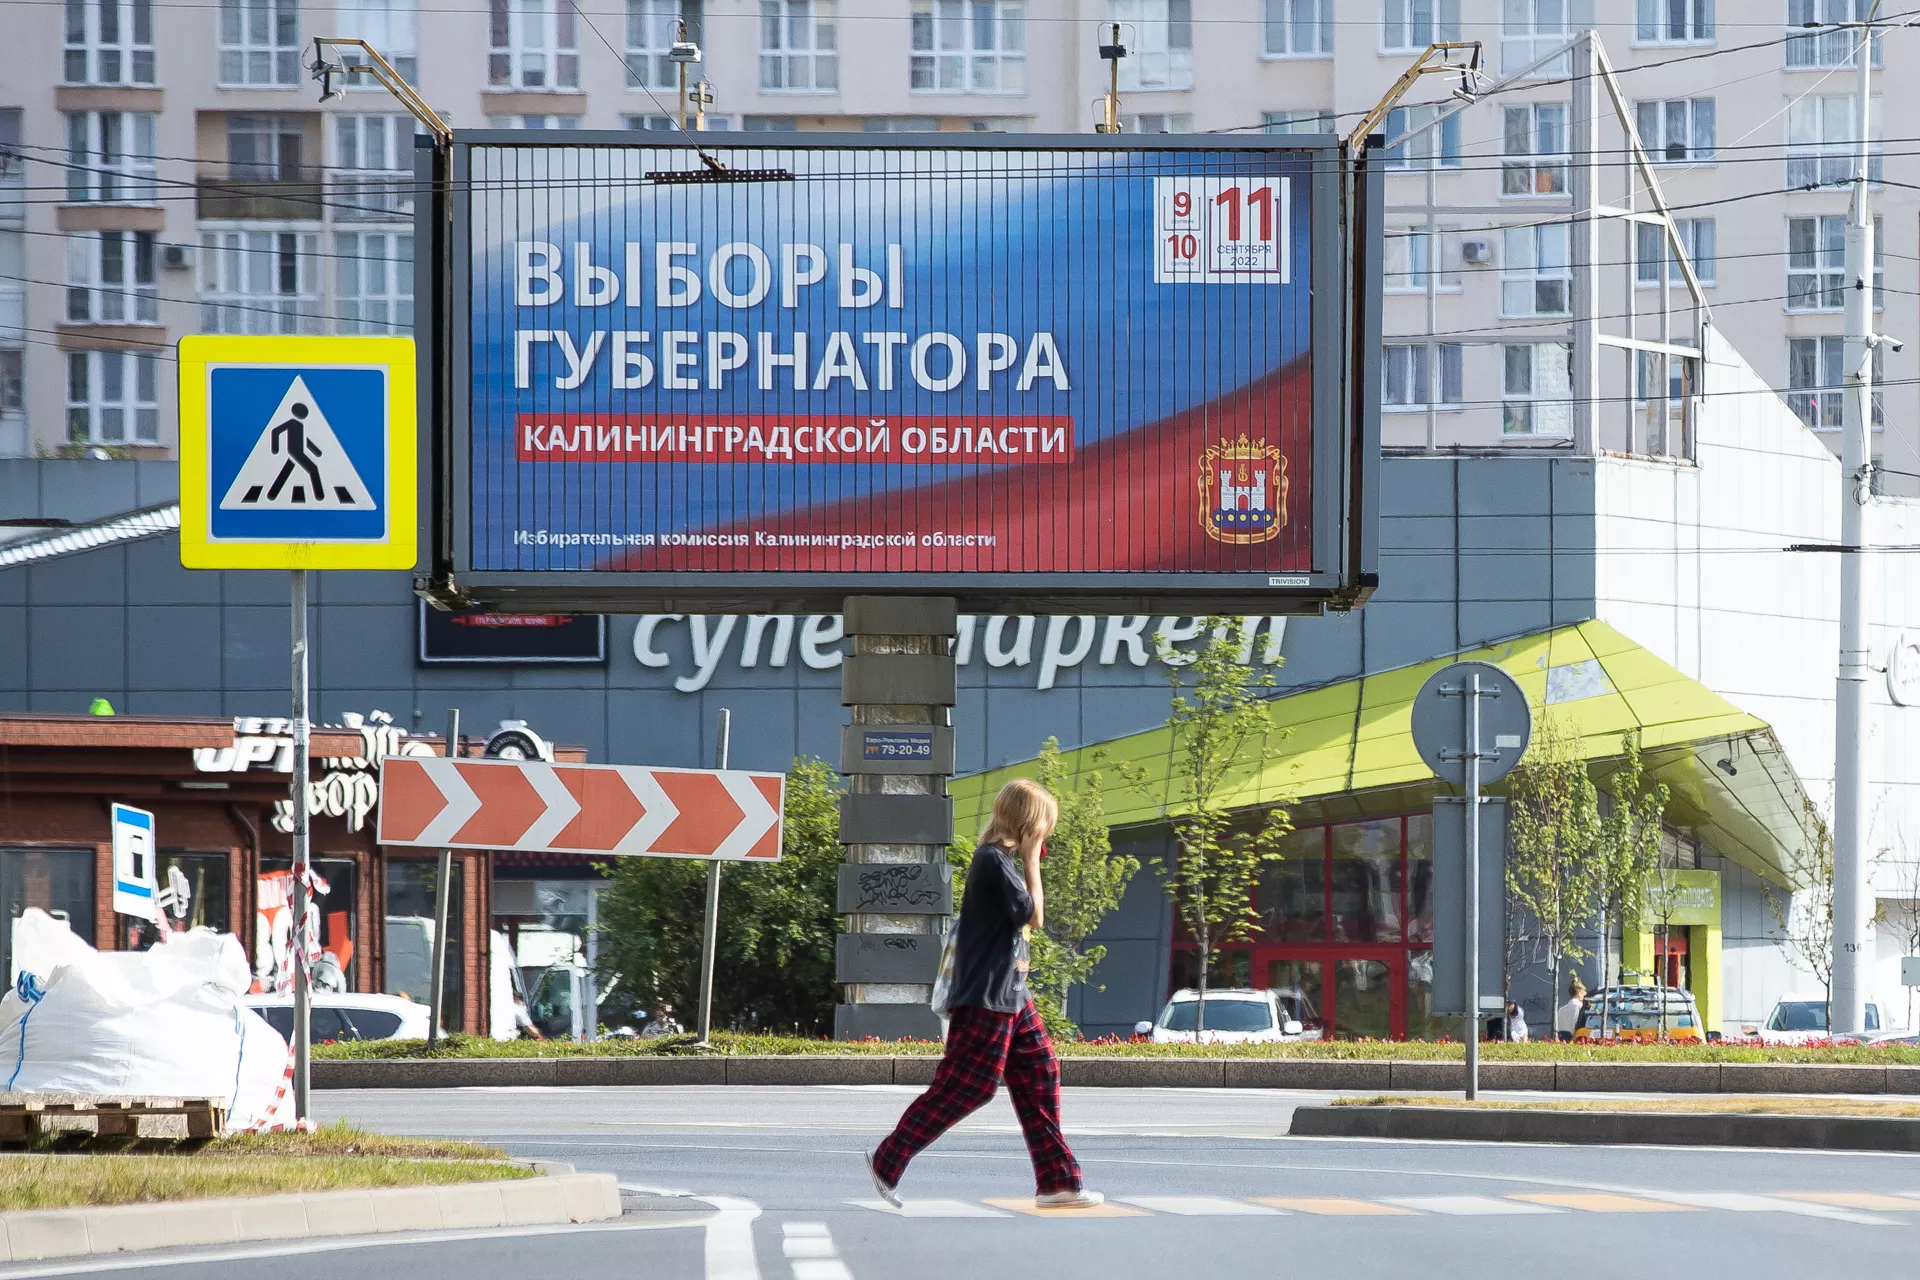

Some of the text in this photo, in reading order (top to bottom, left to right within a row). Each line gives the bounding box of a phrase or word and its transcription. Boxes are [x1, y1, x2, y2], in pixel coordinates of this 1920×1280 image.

[1173, 191, 1192, 217] 9
[1216, 187, 1272, 241] 11
[1167, 234, 1197, 259] 10
[1216, 245, 1272, 255] СЕНТЯБРЯ
[1230, 256, 1258, 266] 2022
[515, 240, 905, 309] ВЫБОРЫ
[514, 329, 1071, 393] ГУБЕРНАТОРА
[523, 418, 1066, 460] КАЛИНИНГРАДСКОЙ ОБЛАСТИ
[513, 528, 997, 550] Избирательная комиссия Калининградской области
[882, 745, 930, 755] 79-20-49
